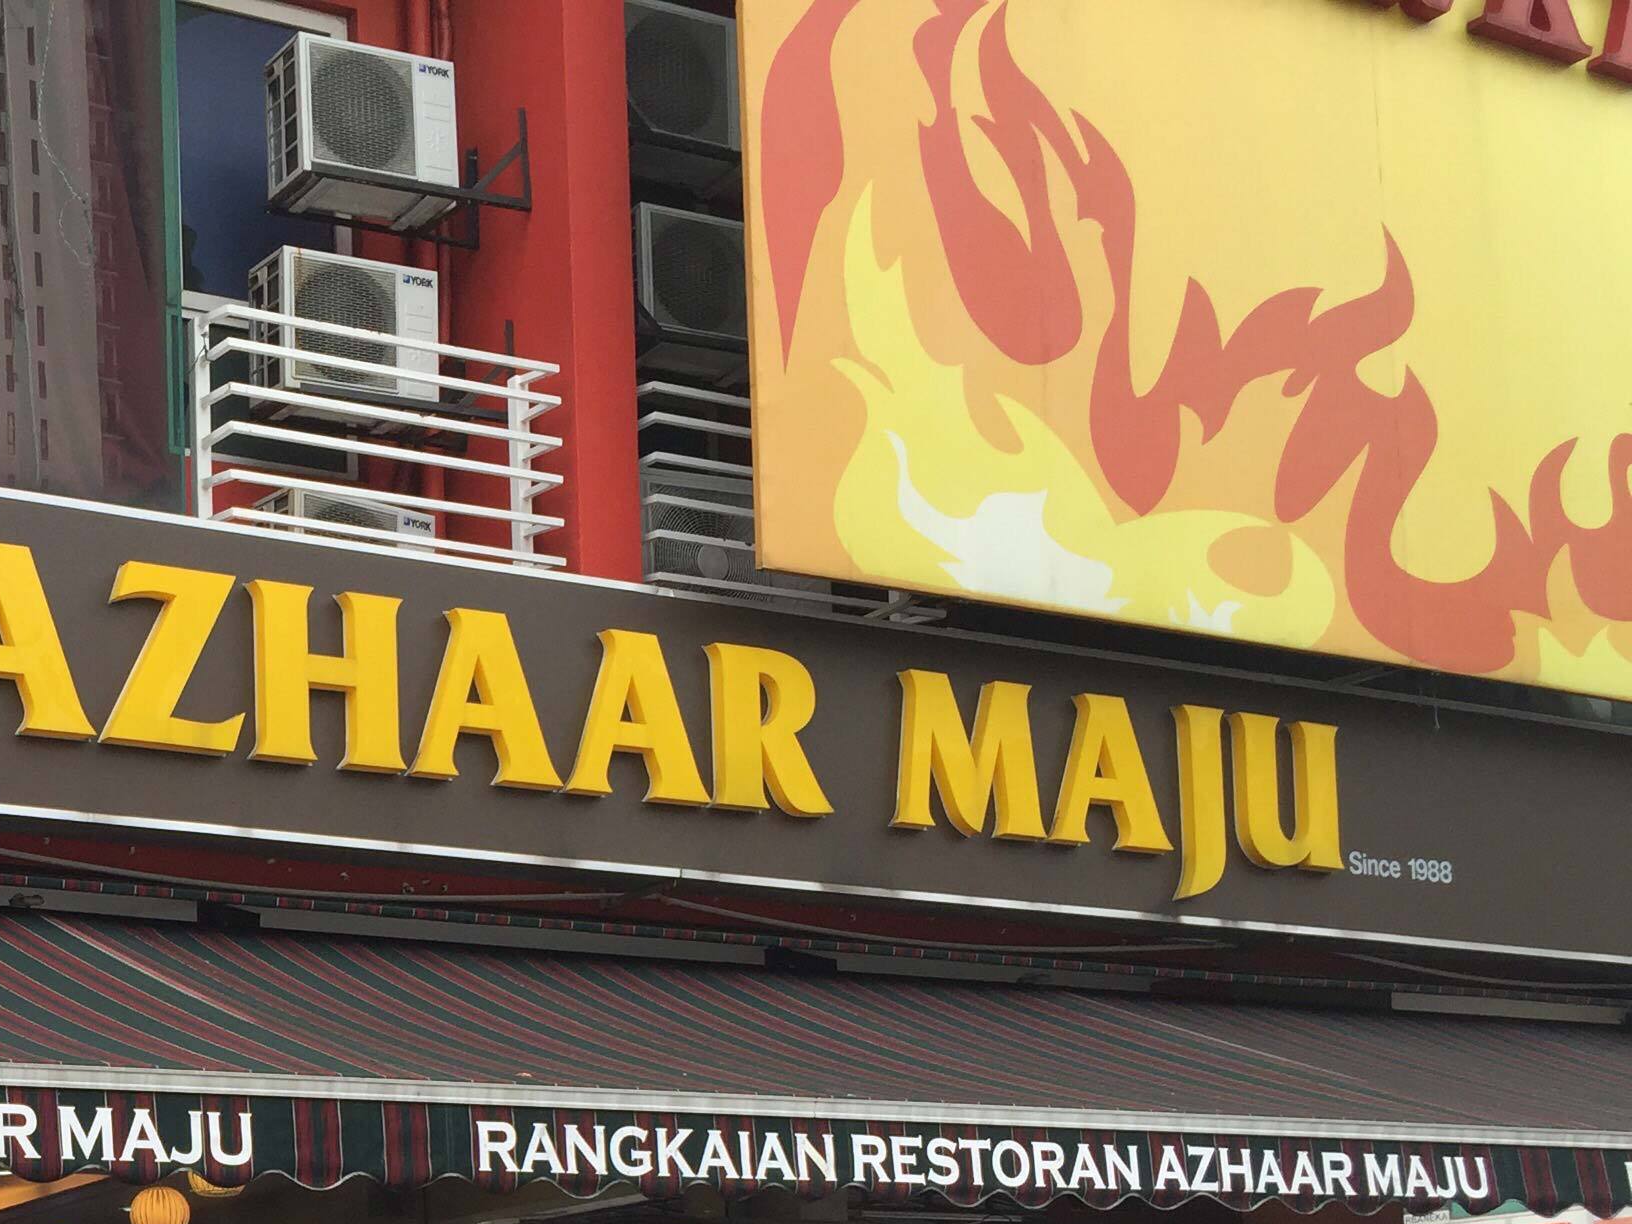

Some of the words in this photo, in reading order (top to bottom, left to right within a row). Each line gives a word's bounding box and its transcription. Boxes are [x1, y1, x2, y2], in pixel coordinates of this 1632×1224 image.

[428, 65, 449, 78] YORK
[411, 275, 434, 288] YORK
[410, 518, 431, 532] YORK
[887, 668, 1345, 901] MAJU
[1348, 850, 1401, 879] Since
[1407, 857, 1453, 884] 1988
[57, 1104, 254, 1167] MAJU
[475, 1120, 837, 1182] RANGKAIAN
[850, 1133, 1142, 1191] RESTORAN
[1153, 1144, 1358, 1196] AZHAAR
[1363, 1152, 1492, 1199] MAJU
